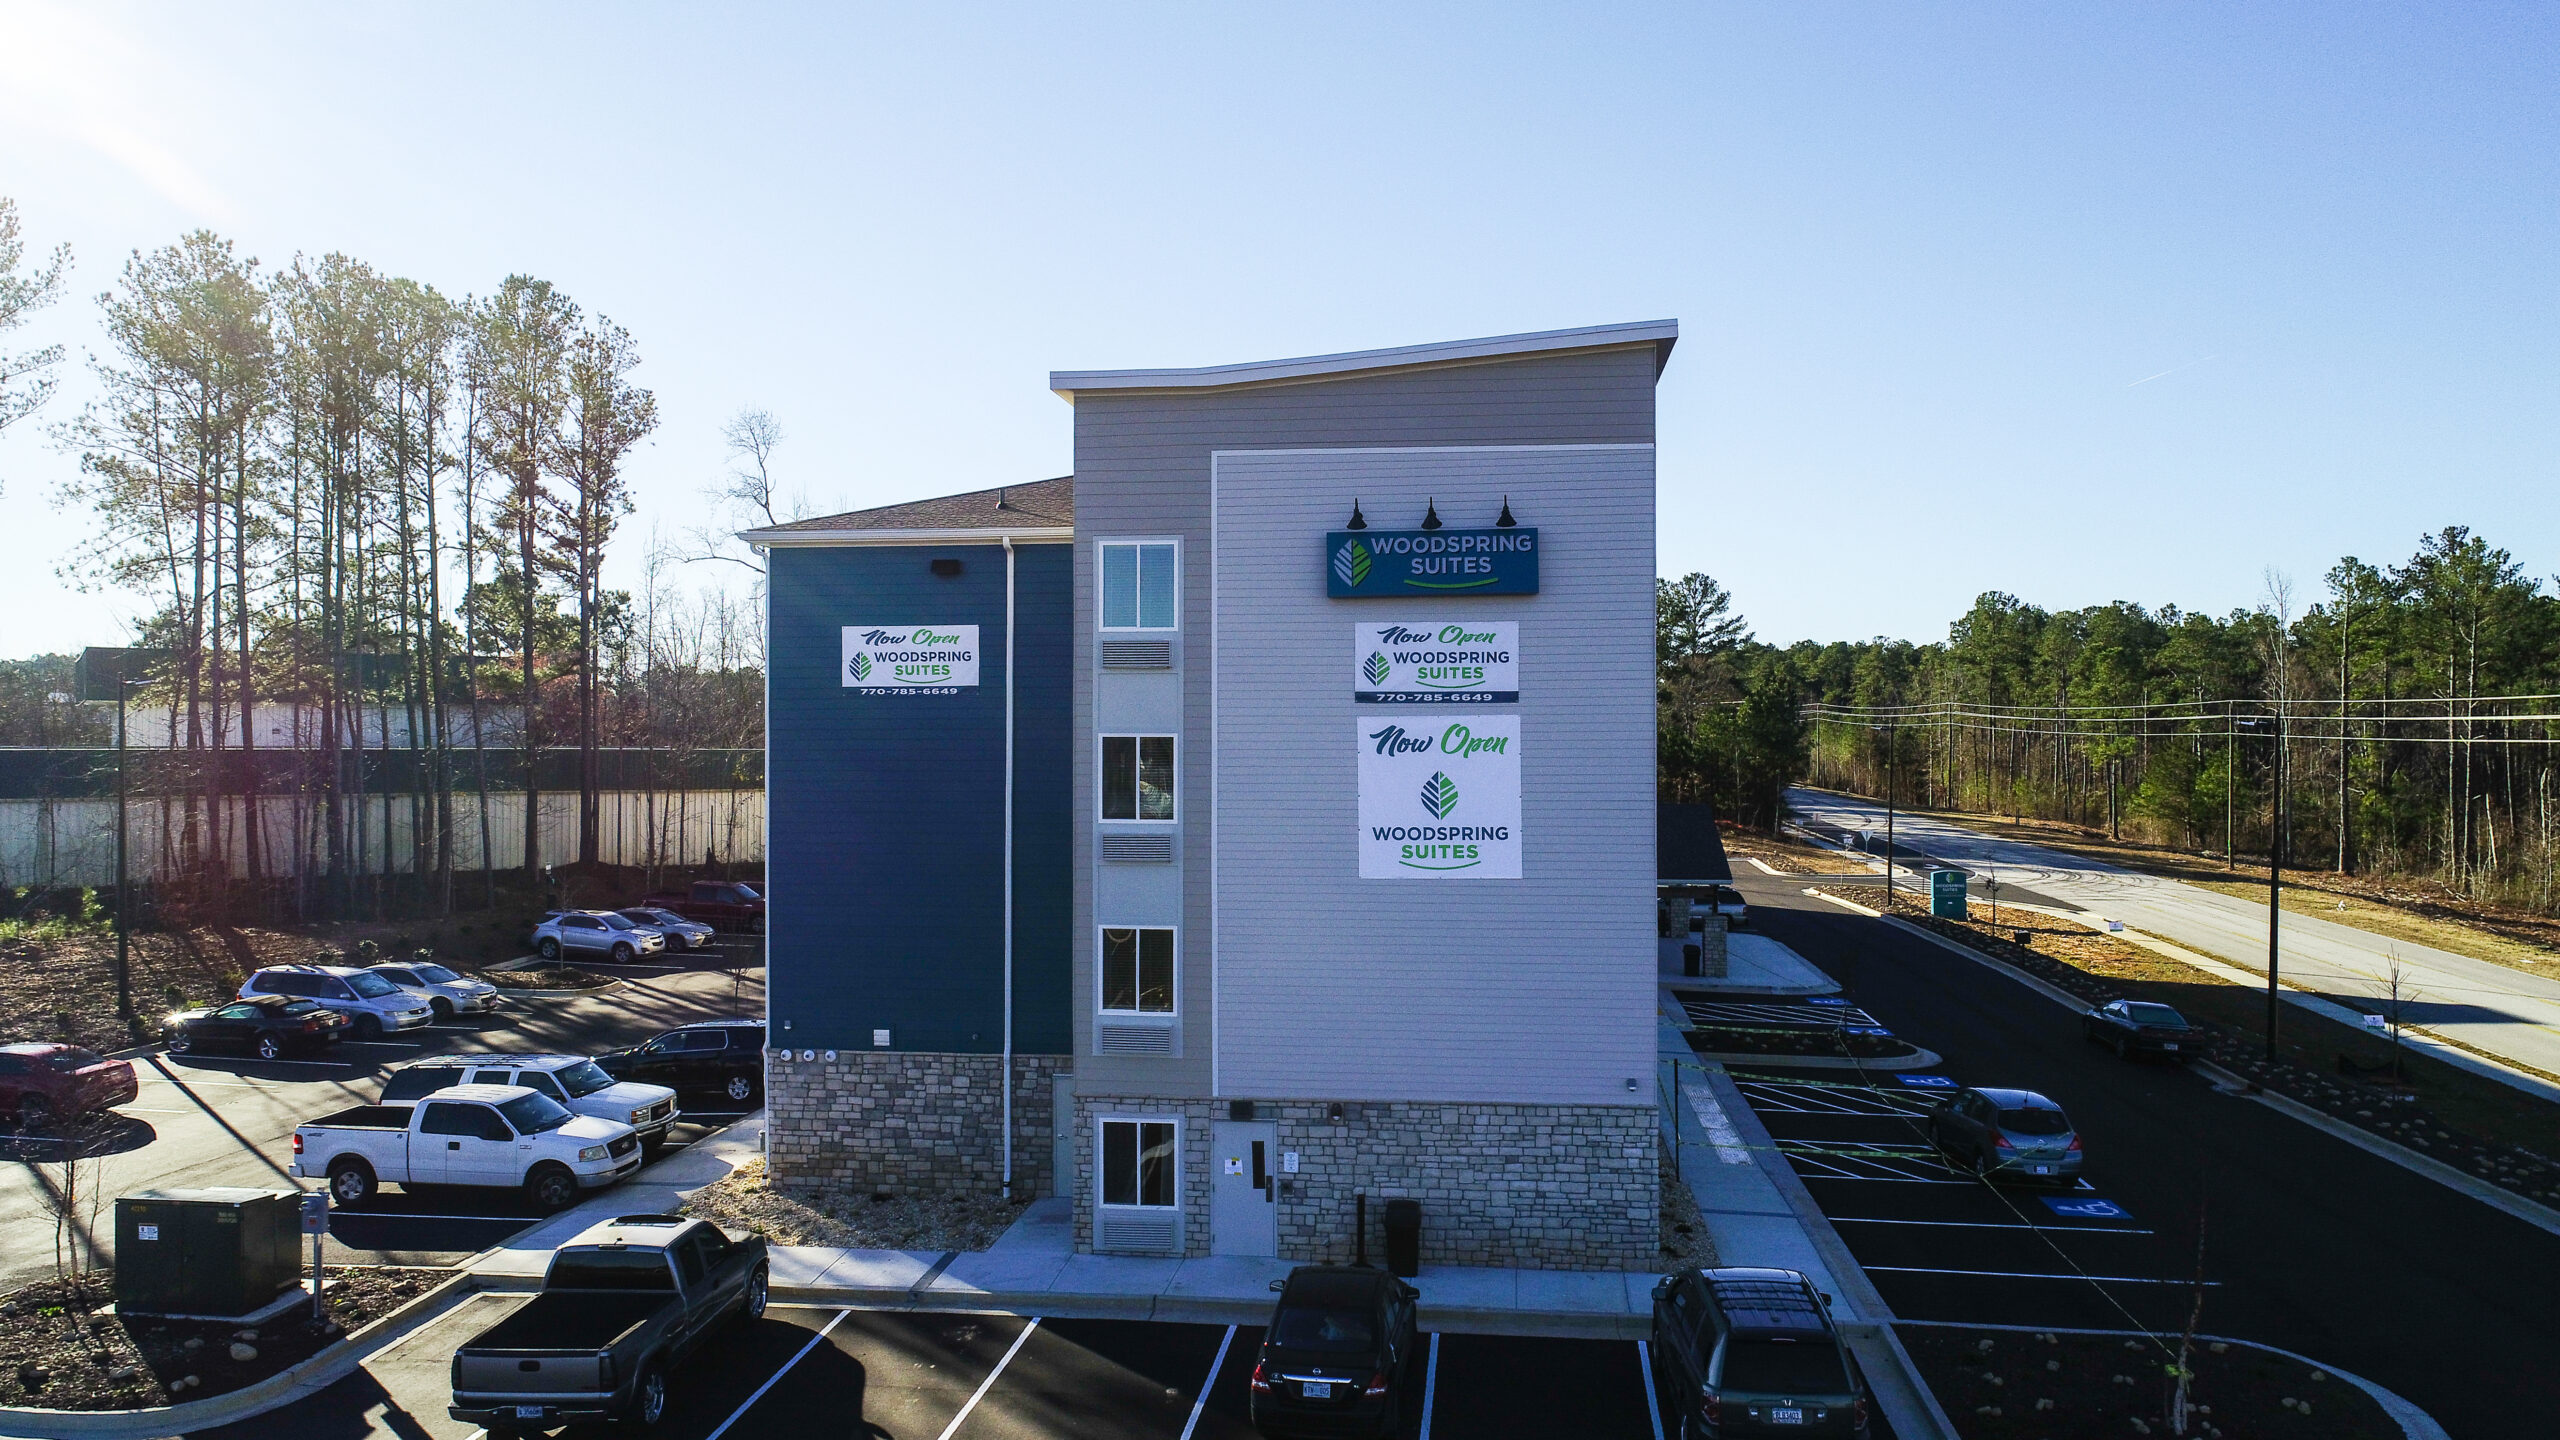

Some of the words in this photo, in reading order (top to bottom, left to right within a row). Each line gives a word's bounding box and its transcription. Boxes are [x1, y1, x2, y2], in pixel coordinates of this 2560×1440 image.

[1371, 534, 1532, 555] WOODSPRING
[1410, 557, 1492, 575] SUITES
[860, 629, 907, 647] Now
[911, 628, 961, 647] Open
[1376, 626, 1433, 645] Now
[1438, 625, 1497, 647] Open
[874, 651, 972, 663] WOODSPRING
[1393, 651, 1510, 664] WOODSPRING
[895, 664, 951, 676] SUITES
[1417, 666, 1485, 680] SUITES
[860, 687, 958, 696] 770-785-6649
[1376, 693, 1493, 702] 770-785-6649
[1369, 724, 1434, 757] Now
[1440, 723, 1509, 759] Open
[1372, 826, 1509, 841] WOODSPRING
[1401, 844, 1479, 859] SUITES
